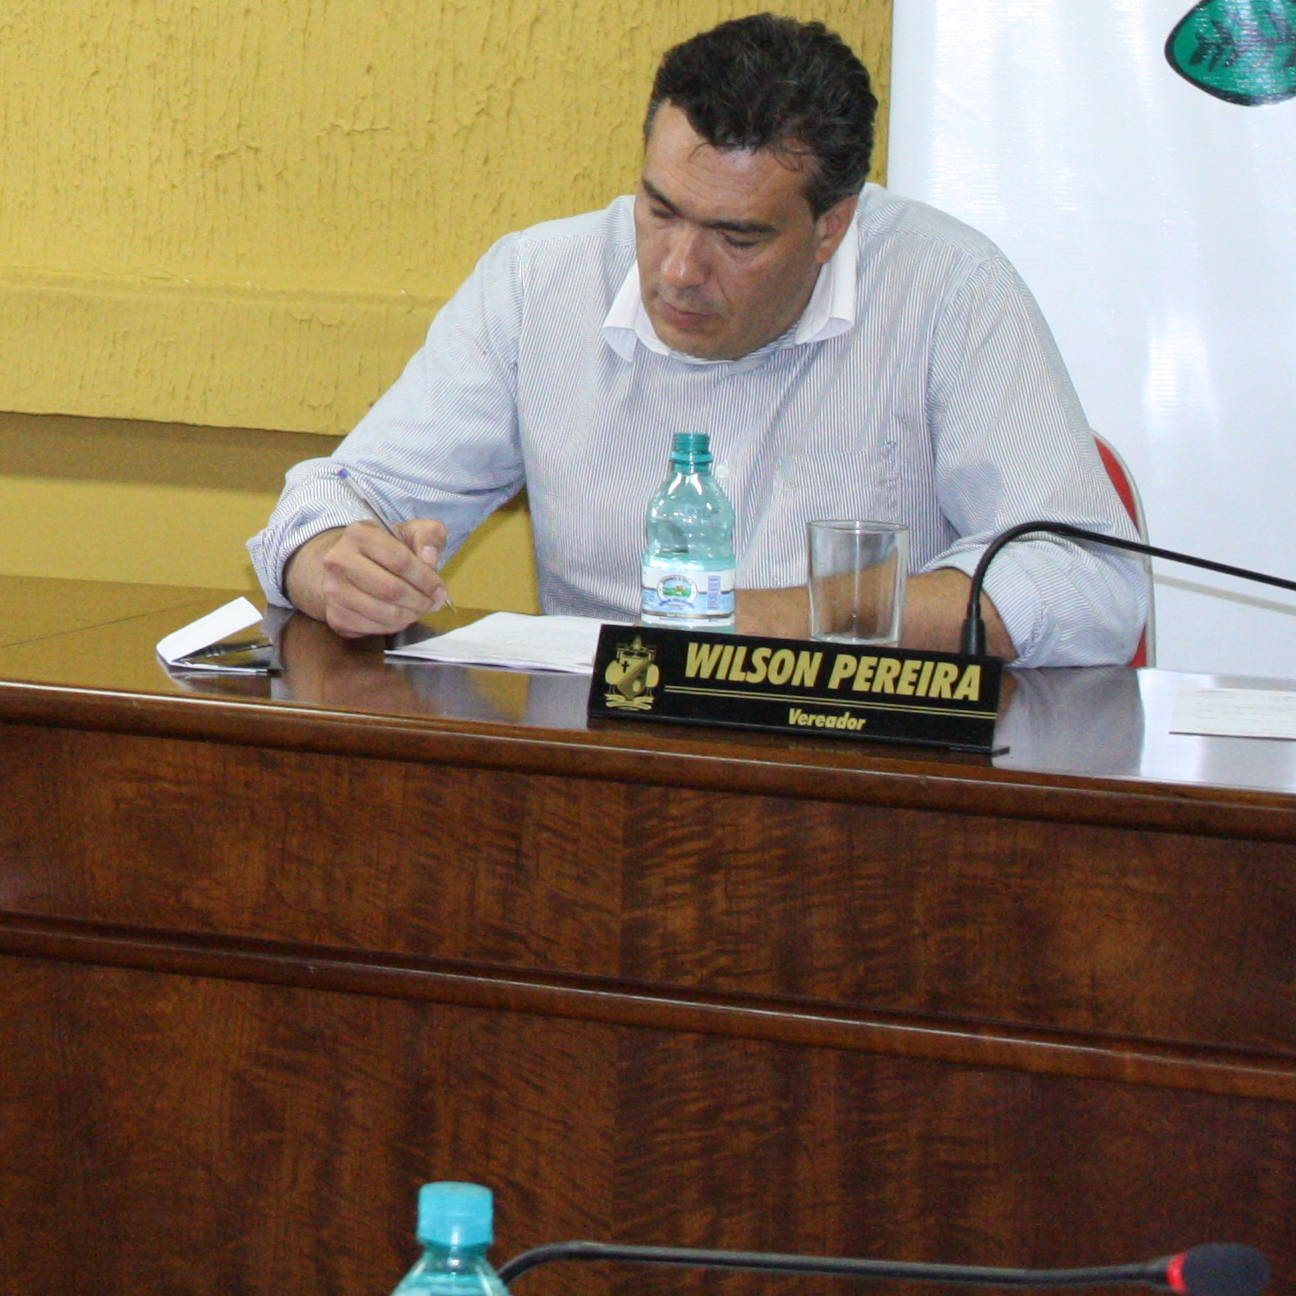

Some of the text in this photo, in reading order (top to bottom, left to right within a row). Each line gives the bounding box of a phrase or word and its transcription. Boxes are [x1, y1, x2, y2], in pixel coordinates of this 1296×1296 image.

[685, 642, 982, 702] WILSON PEREIRA
[788, 707, 867, 731] Vereador
